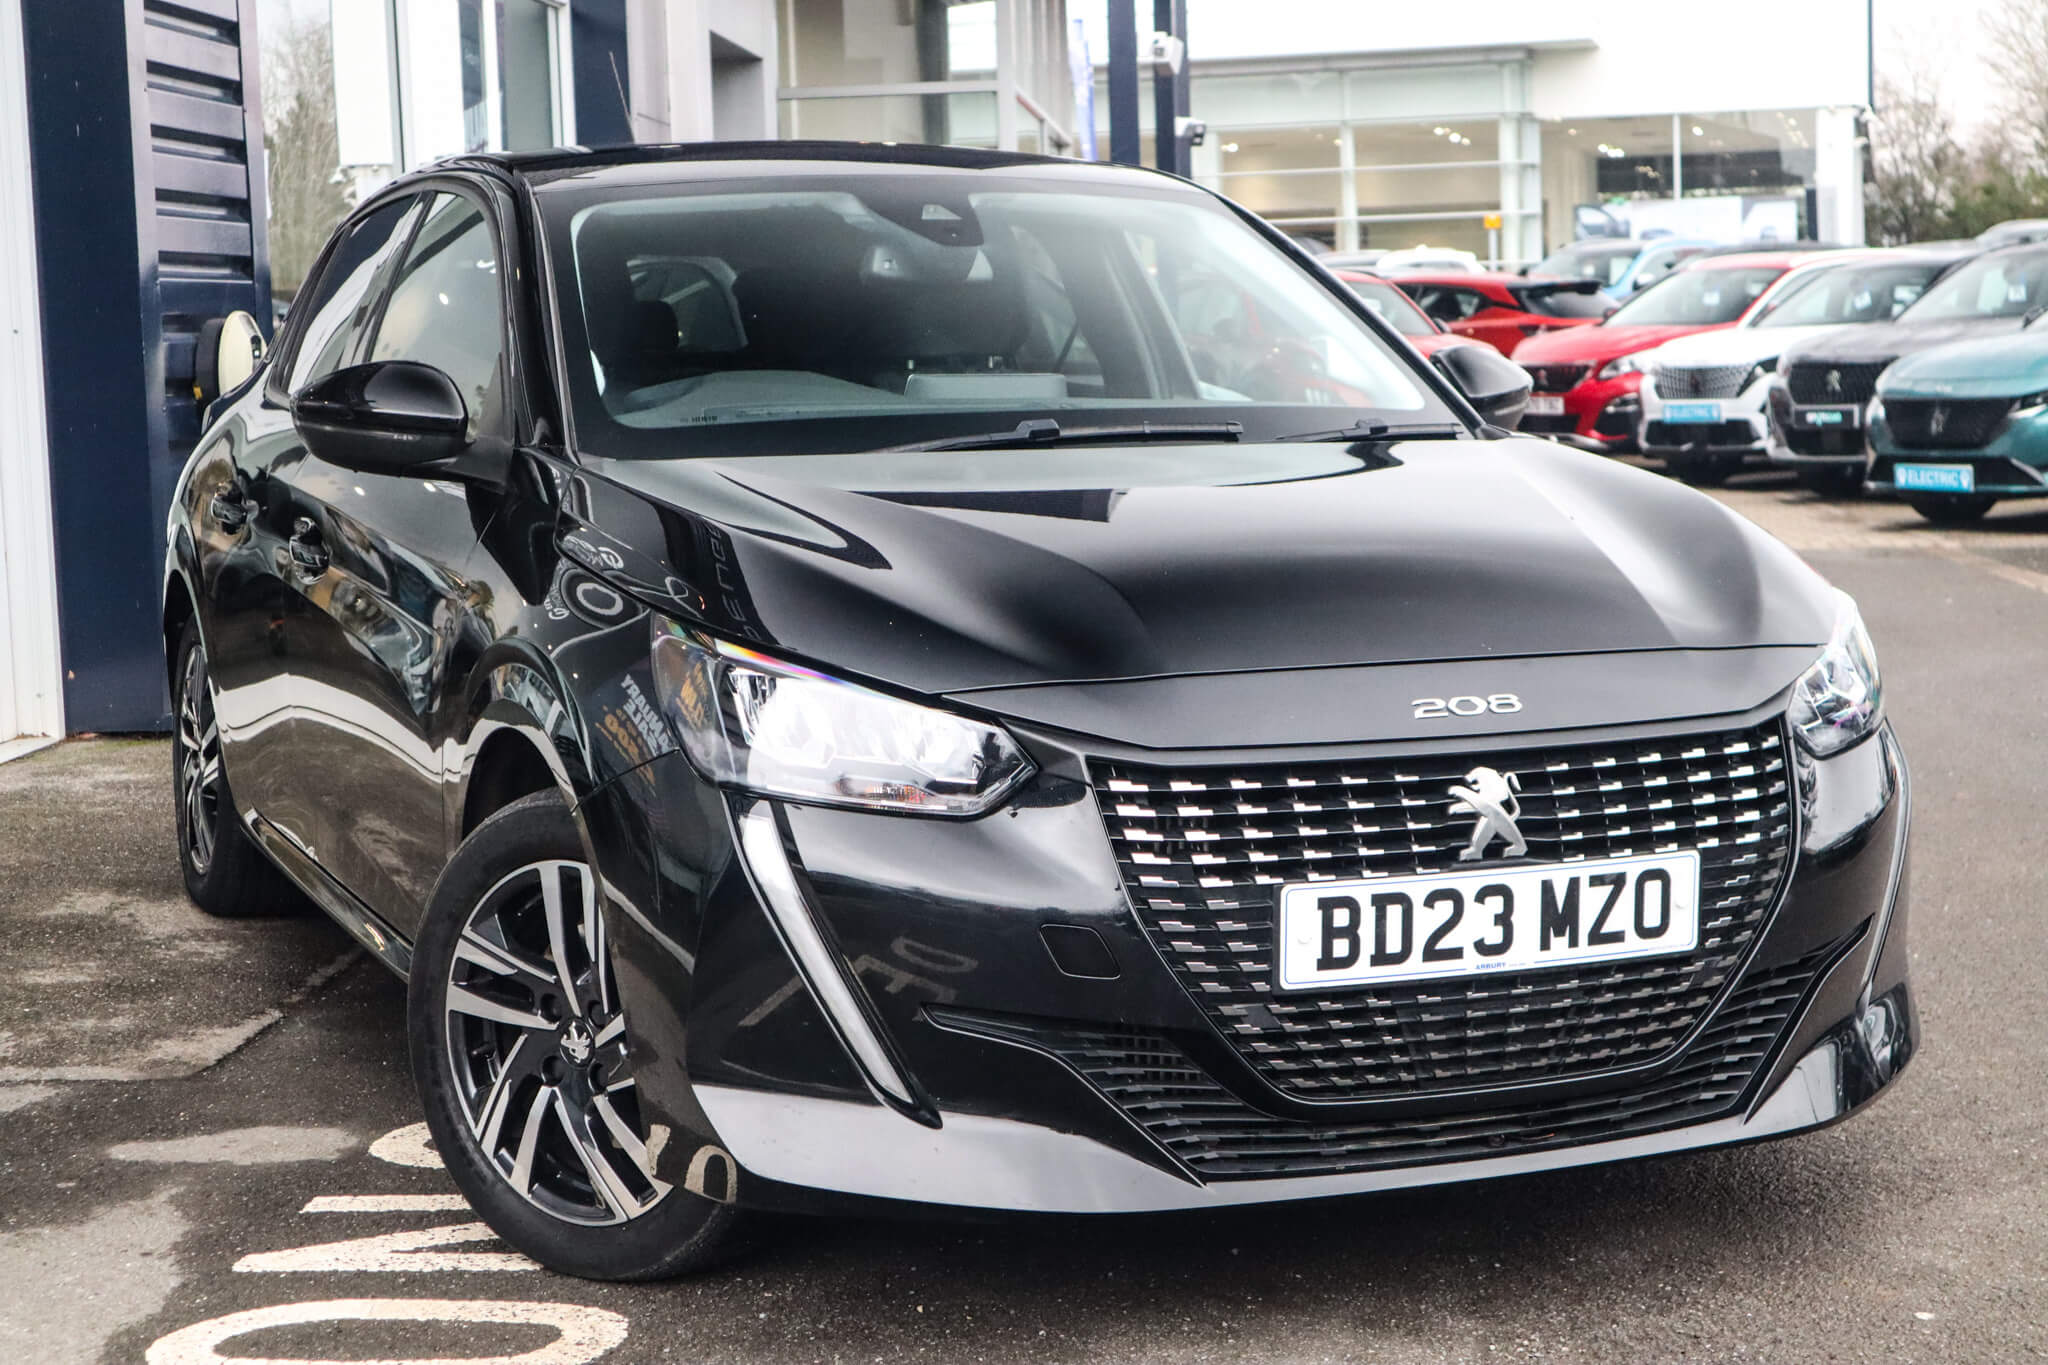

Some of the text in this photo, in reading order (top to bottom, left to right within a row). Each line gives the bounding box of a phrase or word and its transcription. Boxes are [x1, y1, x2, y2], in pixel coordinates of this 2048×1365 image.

[1907, 469, 1959, 487] ELECTRIC
[1411, 693, 1523, 719] 208
[1316, 868, 1671, 972] BD23 MZO
